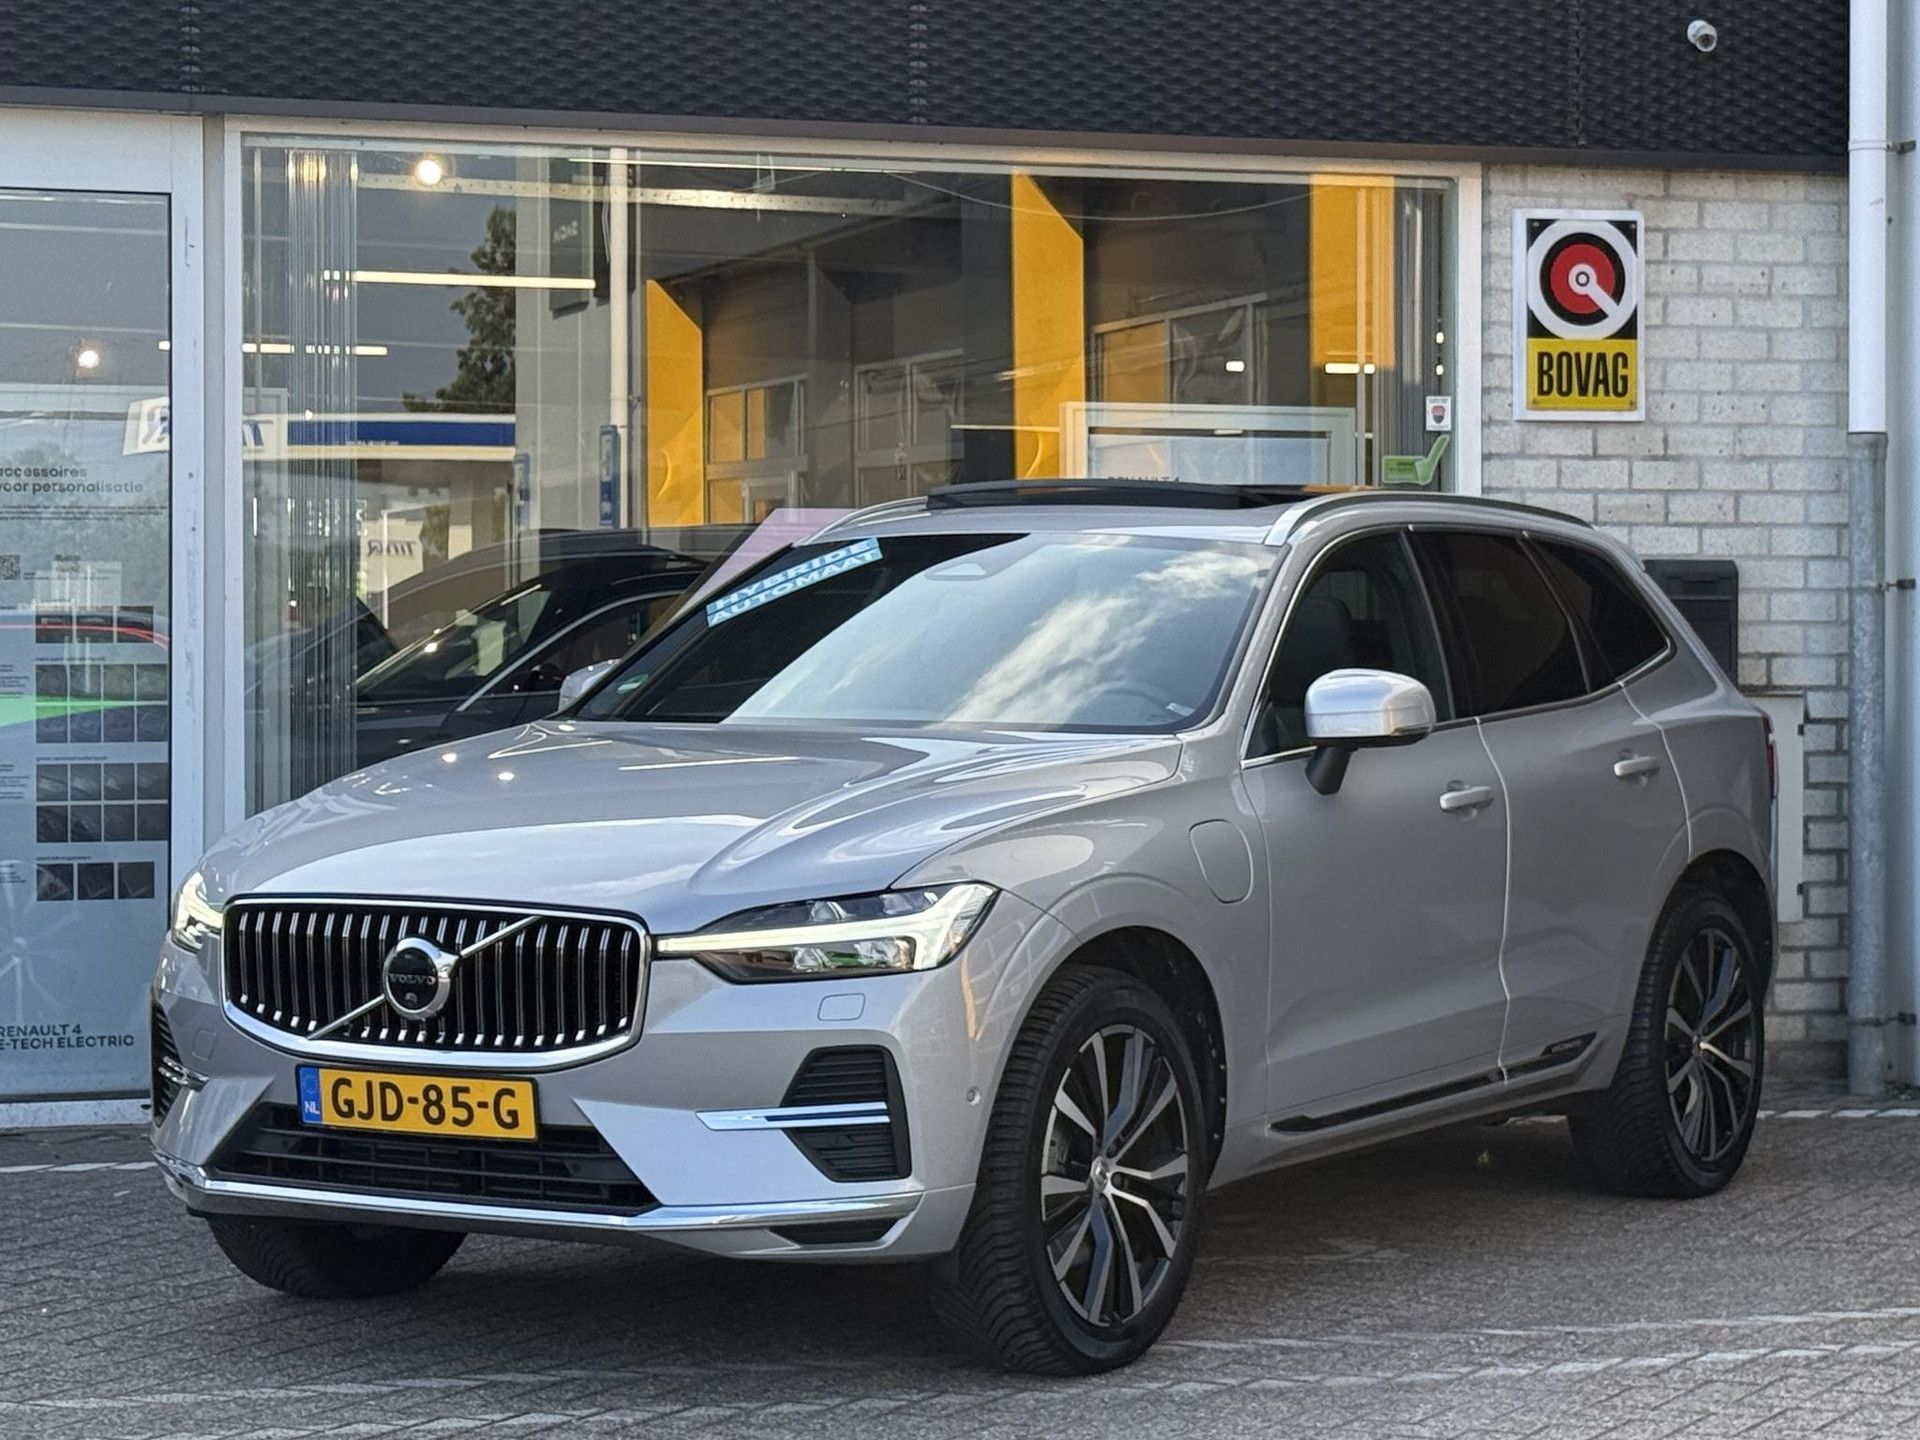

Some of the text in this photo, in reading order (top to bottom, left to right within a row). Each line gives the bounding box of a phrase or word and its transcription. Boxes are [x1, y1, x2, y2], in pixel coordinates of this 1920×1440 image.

[1537, 351, 1629, 398] BOVAG
[0, 481, 144, 495] oor personalisatie
[715, 540, 872, 610] HYBRIDE
[710, 551, 875, 622] AUTOMAAT
[389, 973, 436, 985] VOLVO
[0, 1023, 82, 1038] RENAULT 4
[57, 1034, 135, 1049] ELECTRIC
[304, 1100, 321, 1115] NL
[331, 1077, 520, 1130] GJD-85-G
